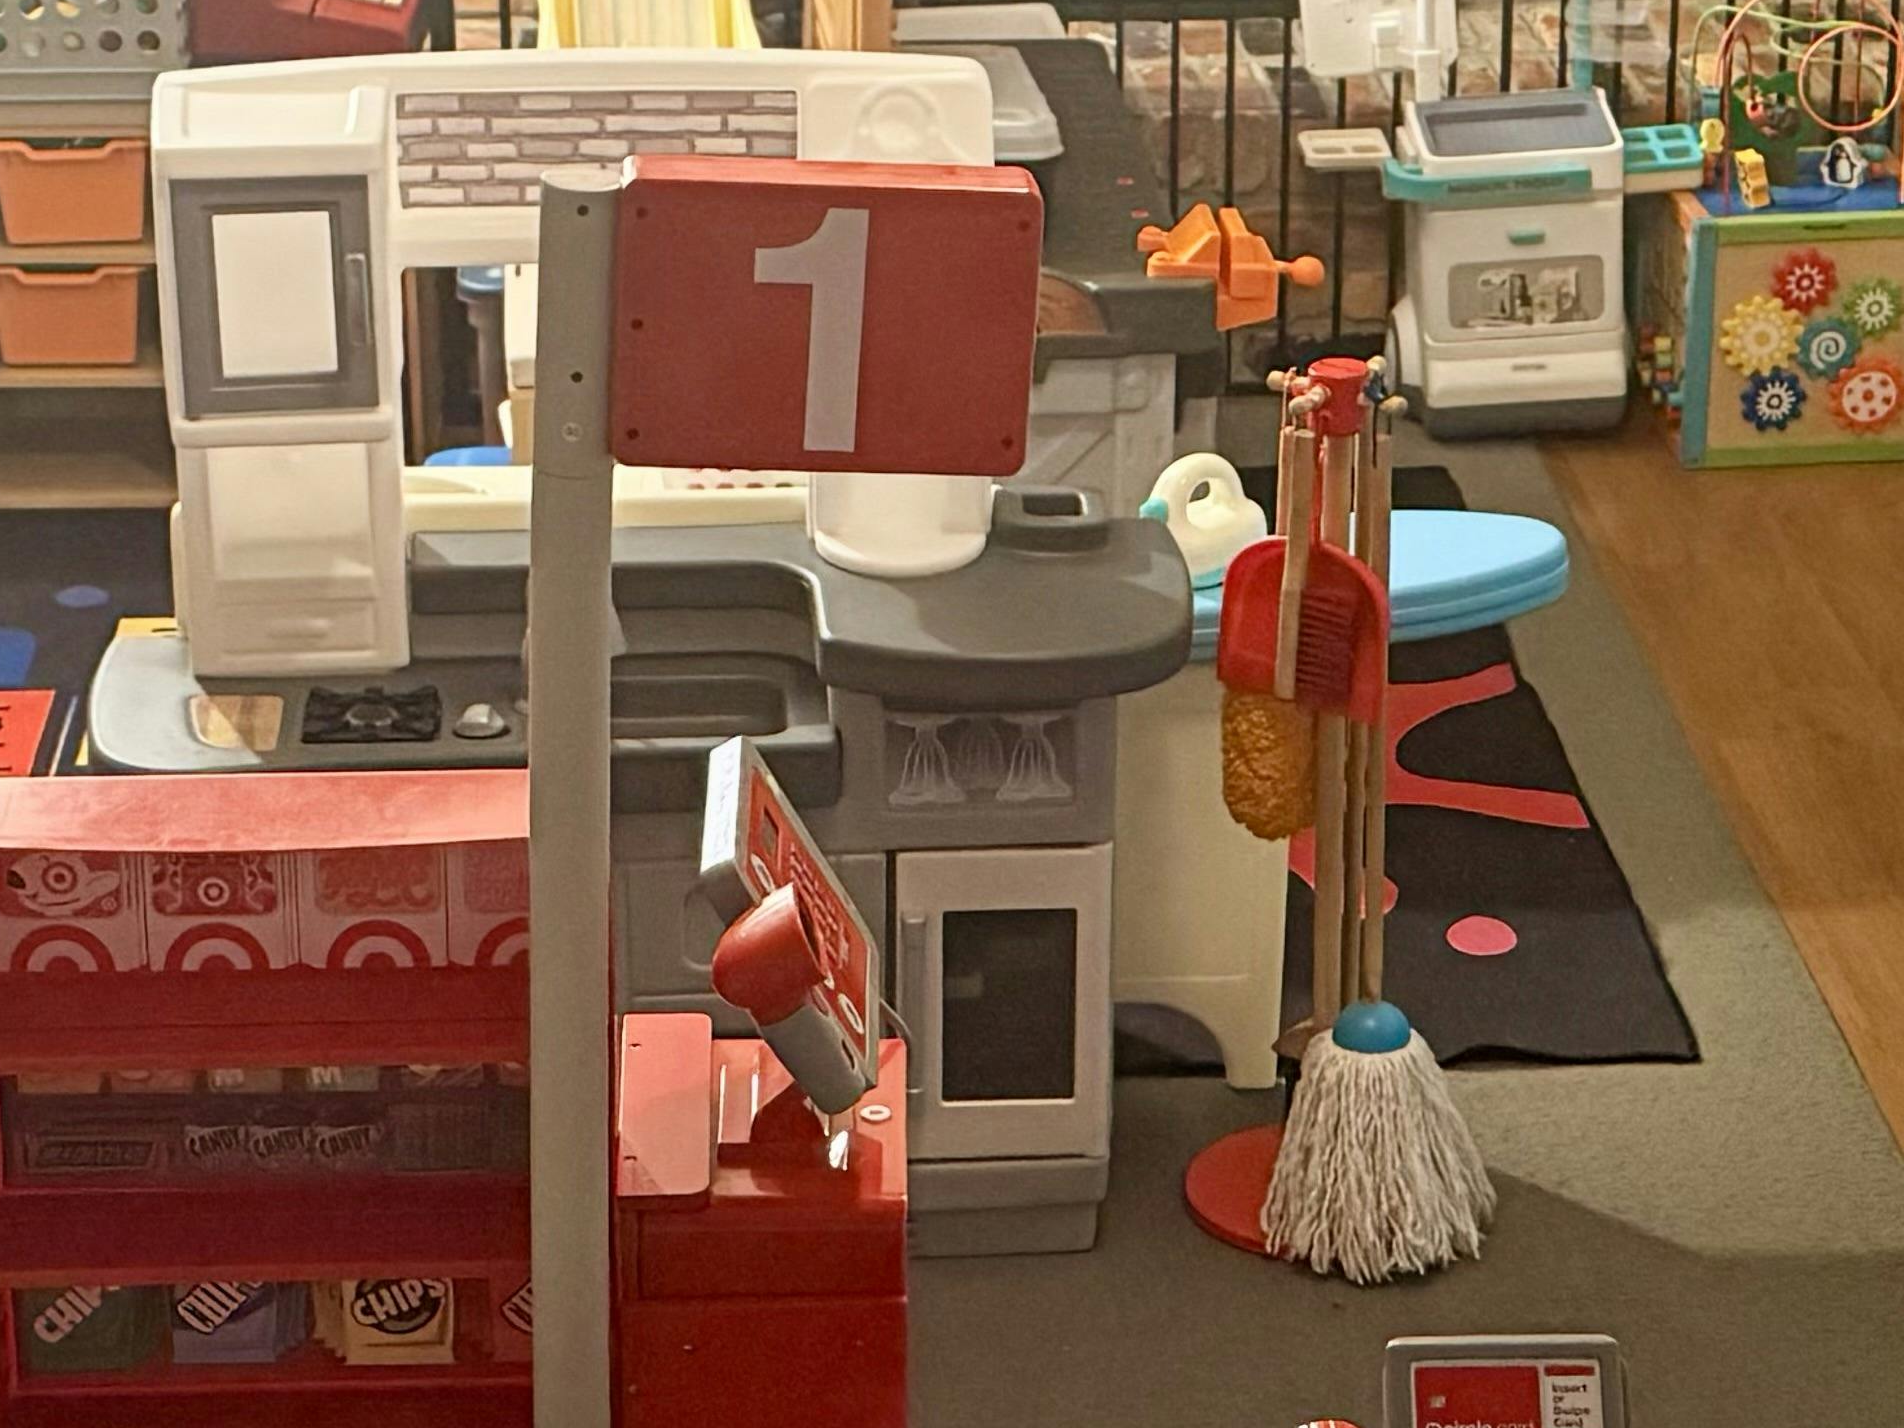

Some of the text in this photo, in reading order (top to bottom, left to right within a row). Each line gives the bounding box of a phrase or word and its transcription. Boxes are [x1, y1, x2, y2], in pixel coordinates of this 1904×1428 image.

[754, 208, 869, 453] 1
[189, 1126, 243, 1156] CANDY
[252, 1128, 304, 1158] CANDY
[318, 1127, 373, 1158] CANDY
